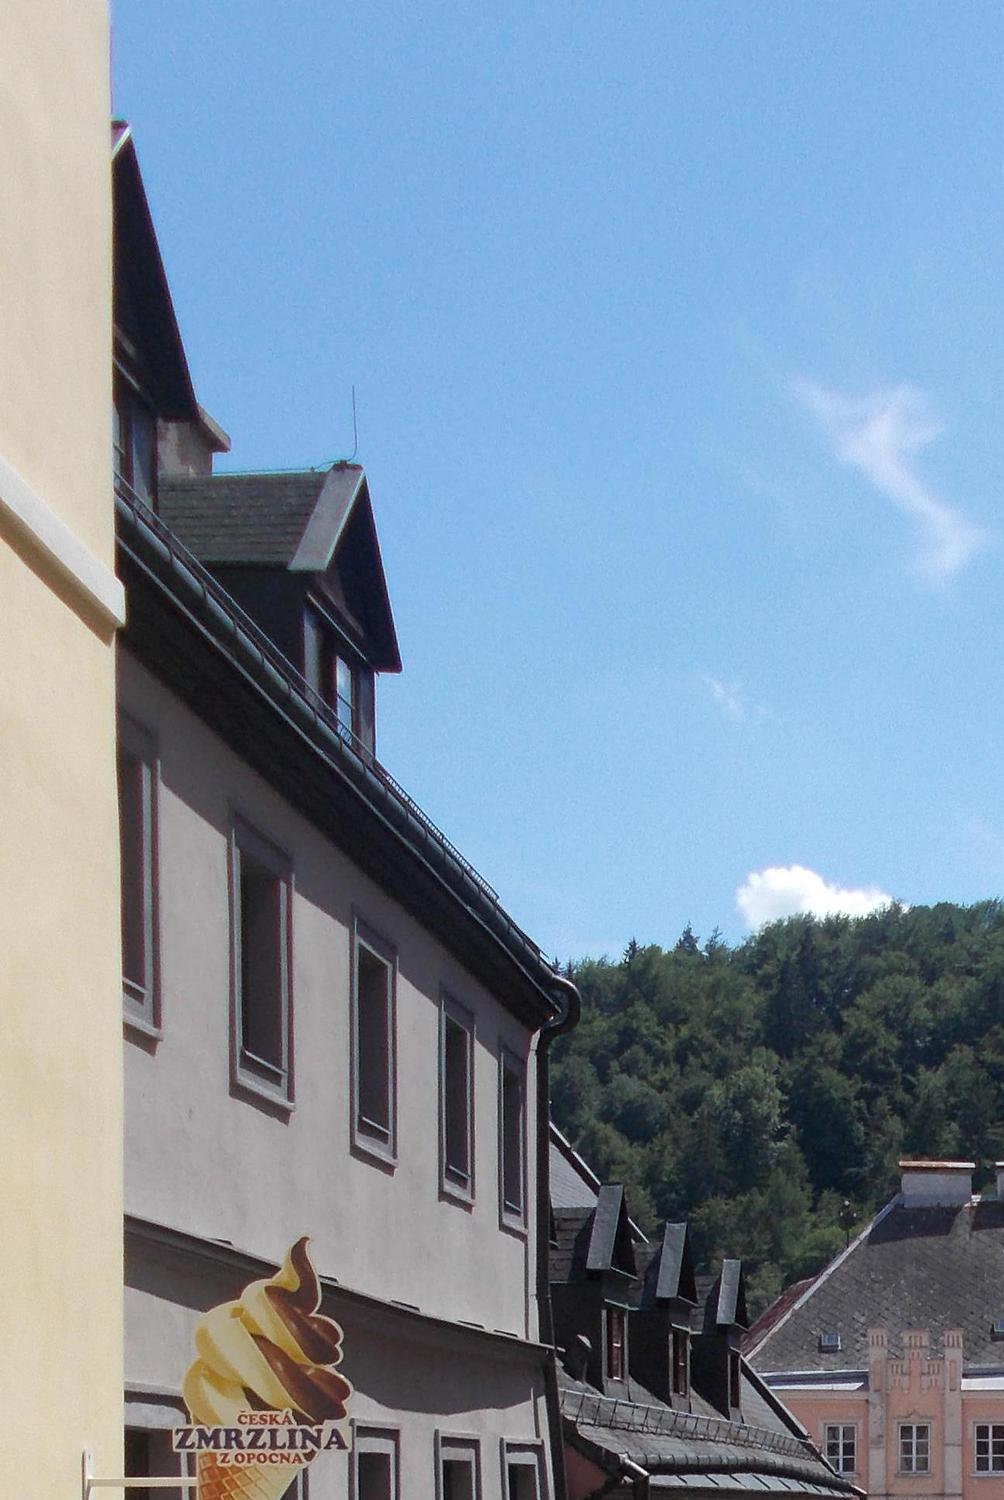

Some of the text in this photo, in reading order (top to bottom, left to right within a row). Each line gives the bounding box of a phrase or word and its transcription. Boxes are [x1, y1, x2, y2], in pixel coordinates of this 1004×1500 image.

[237, 1410, 293, 1425] ČESKÁ
[175, 1428, 348, 1450] ZMRZLINA
[219, 1452, 304, 1464] Z OPOCNA
